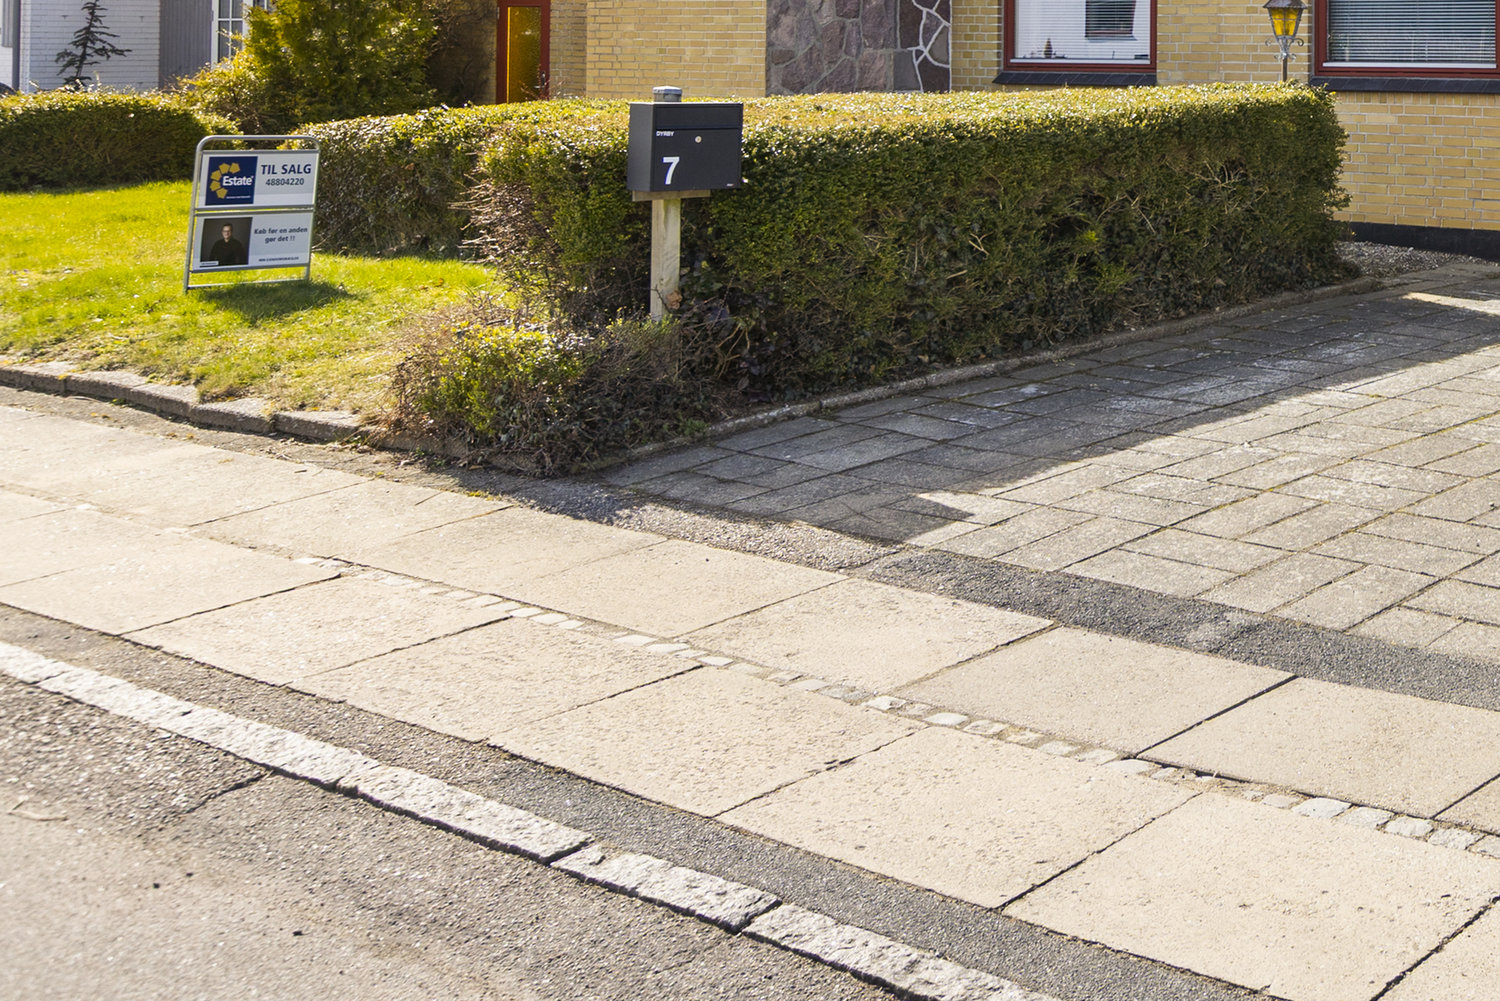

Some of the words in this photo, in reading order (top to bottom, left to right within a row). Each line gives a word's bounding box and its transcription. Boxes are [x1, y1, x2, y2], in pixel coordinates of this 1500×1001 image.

[261, 164, 277, 175] TIL
[281, 163, 312, 174] SALG
[662, 156, 680, 185] 7
[222, 175, 252, 186] Estate
[265, 178, 305, 186] 48804220
